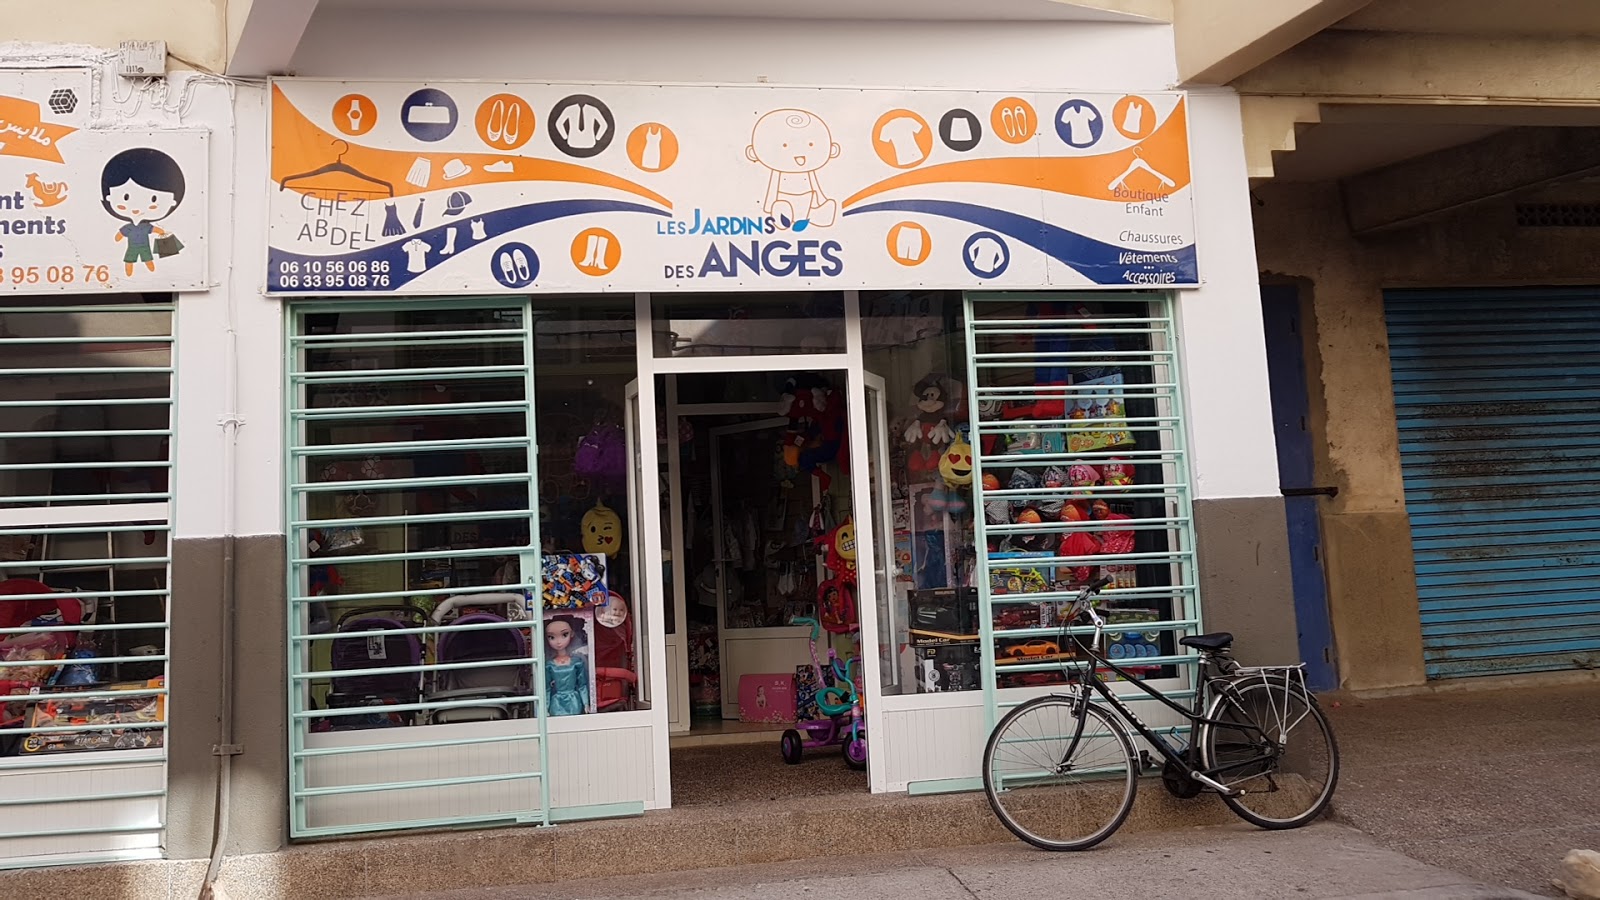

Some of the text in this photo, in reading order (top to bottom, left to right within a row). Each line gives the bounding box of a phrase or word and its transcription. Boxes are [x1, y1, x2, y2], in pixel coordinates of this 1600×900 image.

[1113, 187, 1169, 204] Boutique
[301, 191, 366, 217] CHEZ
[1125, 203, 1164, 217] Enfant
[657, 208, 776, 235] LES JARDINS
[297, 218, 376, 250] ABDEL
[1119, 230, 1184, 245] Chaussures
[665, 240, 843, 279] DES ANGES
[1119, 251, 1178, 265] Vêtements
[11, 265, 40, 283] 95
[46, 265, 74, 283] 08
[82, 265, 109, 283] 76
[280, 261, 390, 274] 06 10 56 06 86
[280, 275, 390, 288] 06 33 95 08 76
[1122, 269, 1176, 285] Accessoires
